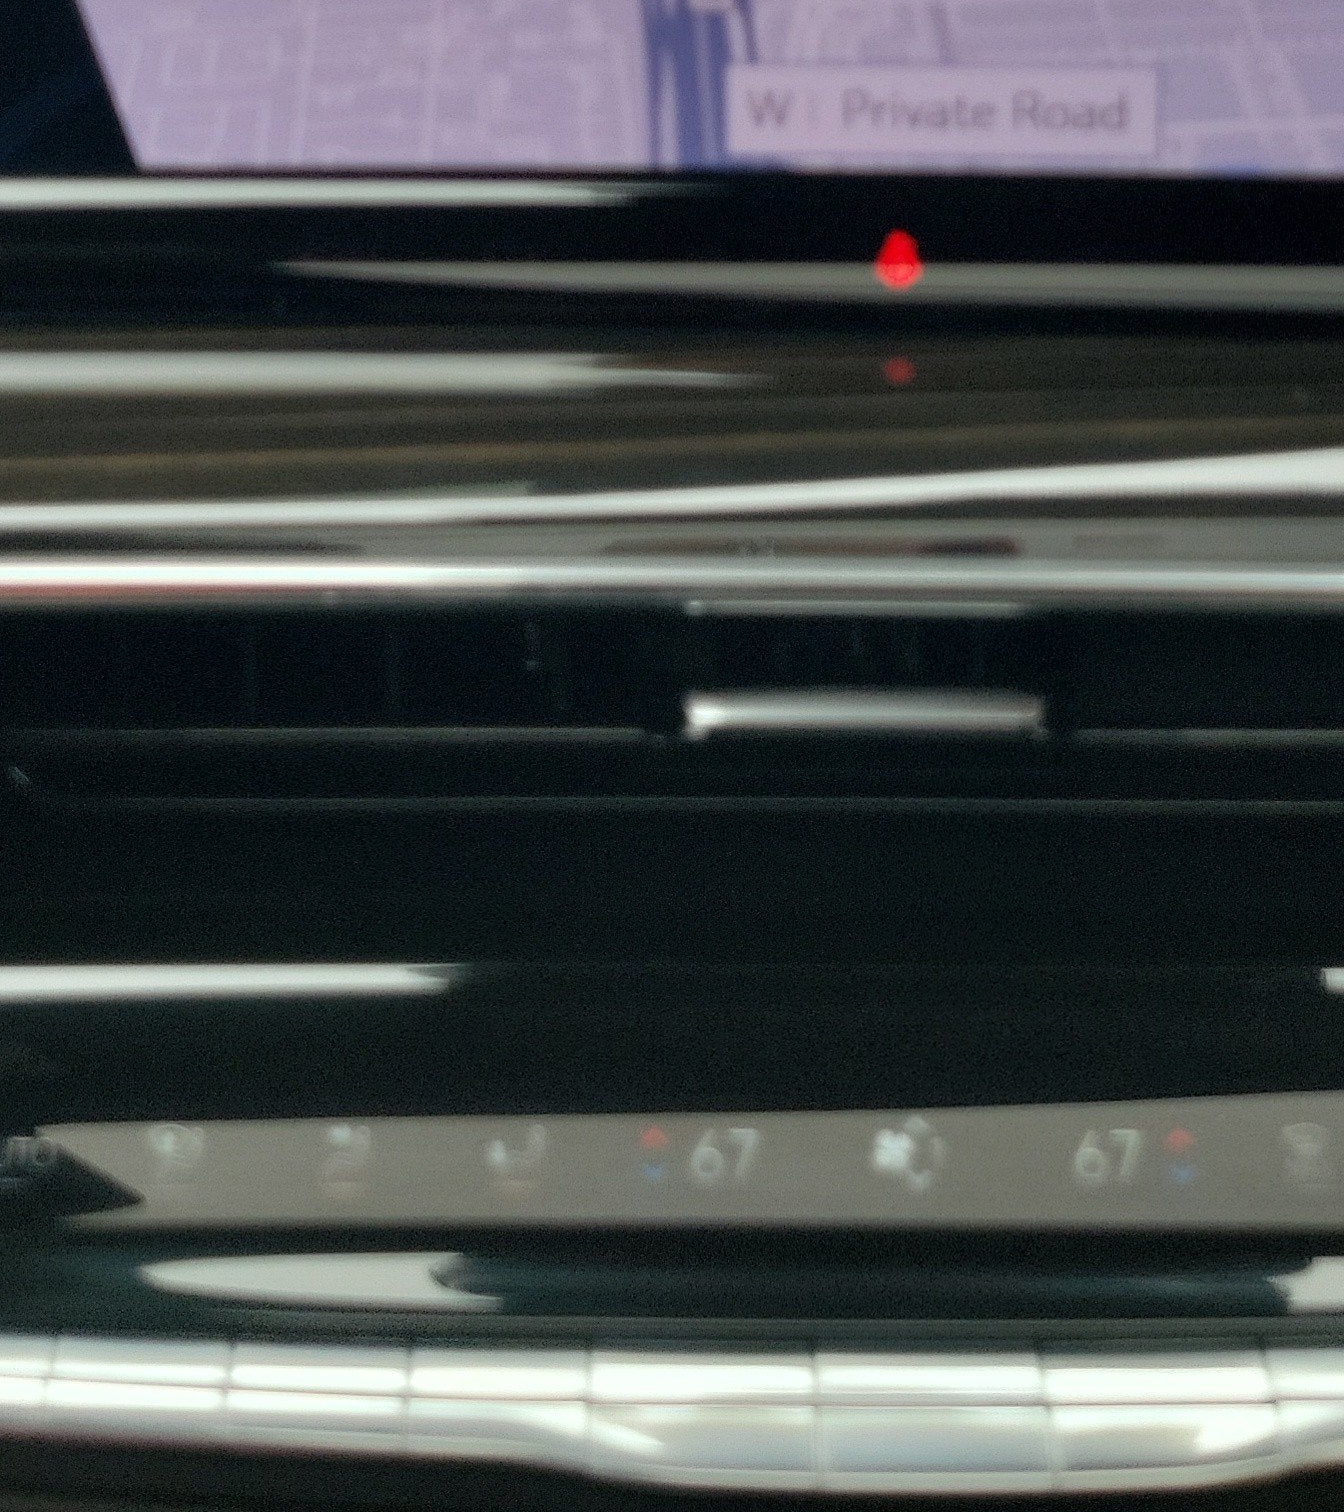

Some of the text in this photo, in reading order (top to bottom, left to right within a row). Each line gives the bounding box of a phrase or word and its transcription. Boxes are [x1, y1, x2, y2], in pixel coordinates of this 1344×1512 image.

[748, 90, 1131, 131] W Private Road
[689, 1125, 762, 1184] 67
[1072, 1126, 1143, 1185] 67
